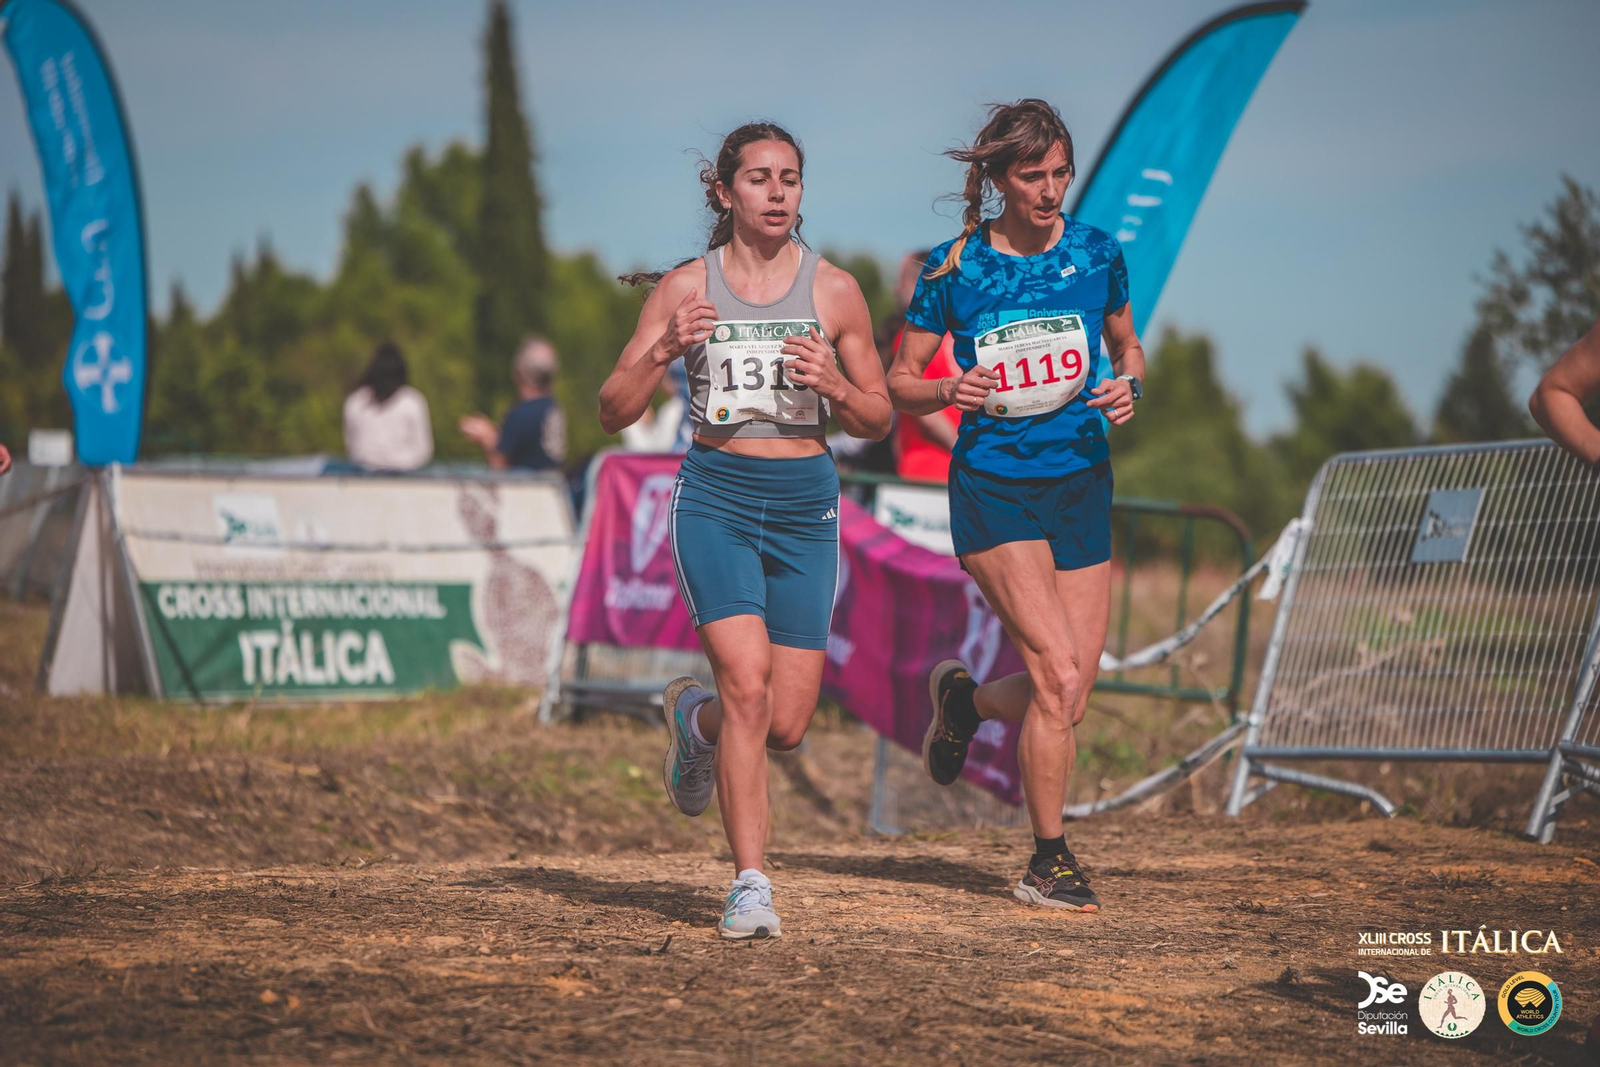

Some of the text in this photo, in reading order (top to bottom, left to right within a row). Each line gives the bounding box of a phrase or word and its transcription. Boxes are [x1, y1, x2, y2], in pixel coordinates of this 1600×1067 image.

[992, 349, 1083, 393] 1119
[157, 584, 448, 620] CROSS INTERNACIONAL
[238, 618, 396, 685] ITÁLICA
